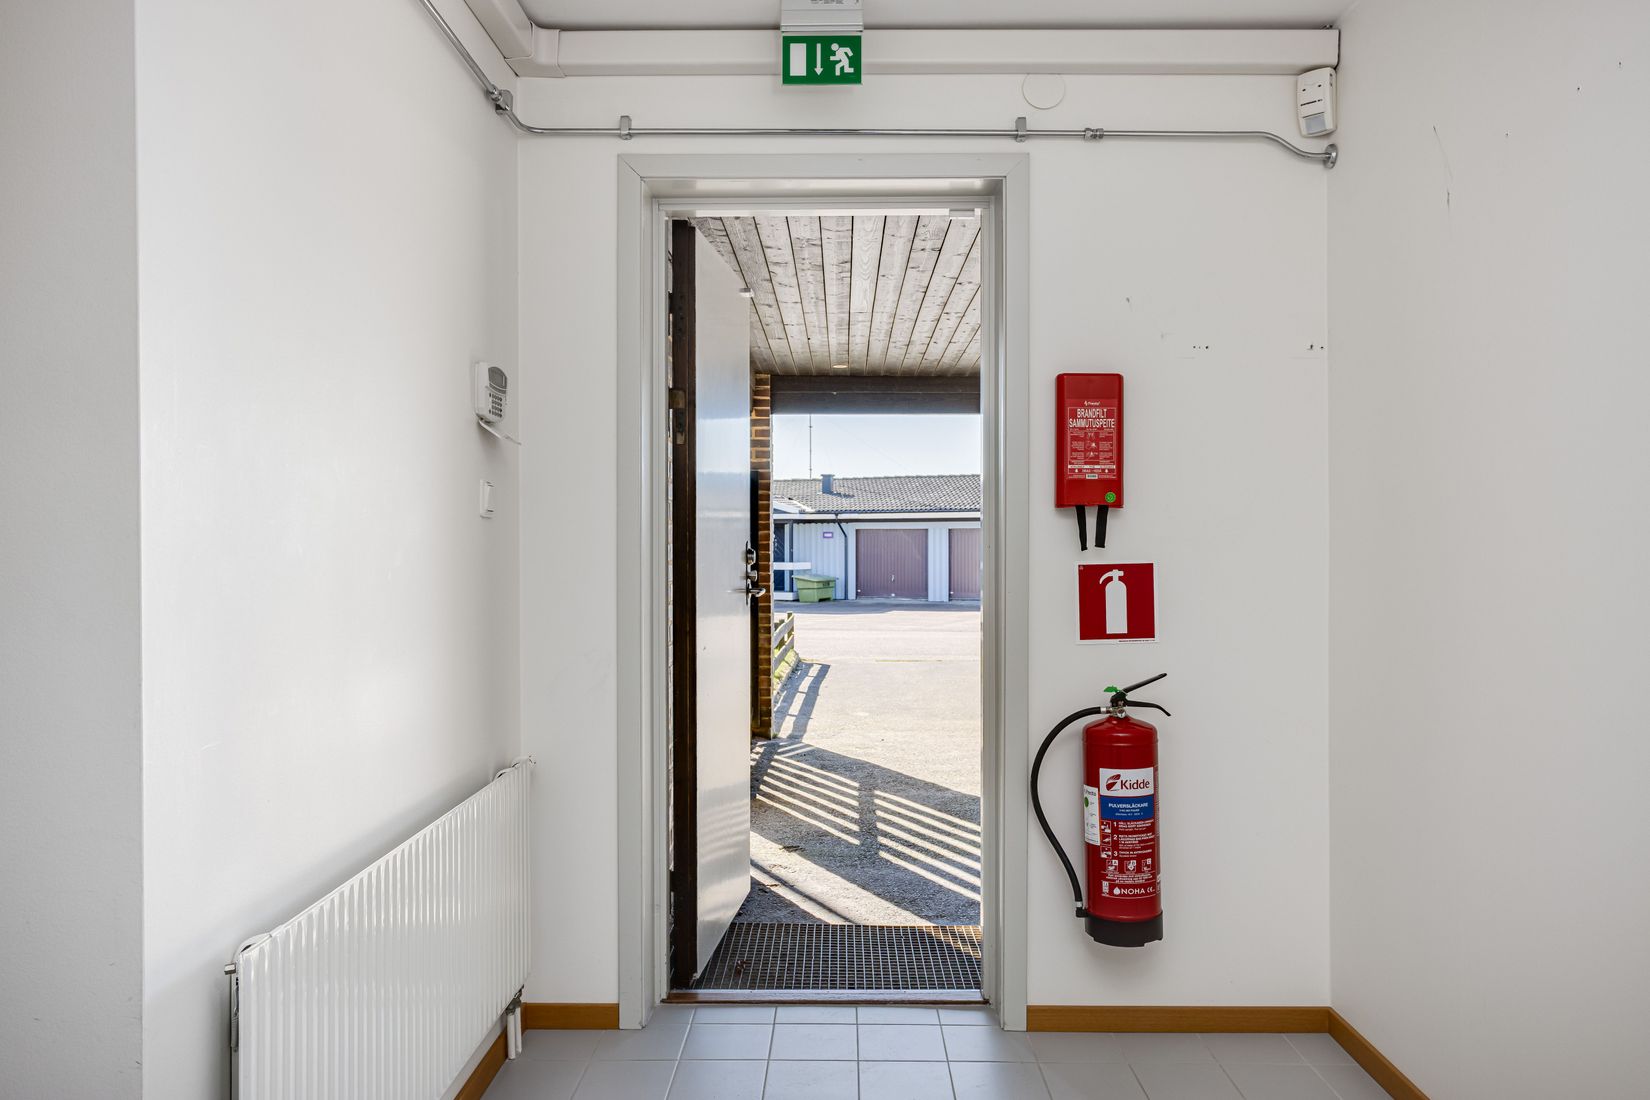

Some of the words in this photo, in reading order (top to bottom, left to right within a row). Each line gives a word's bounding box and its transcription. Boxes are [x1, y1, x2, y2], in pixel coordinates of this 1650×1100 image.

[1076, 408, 1107, 418] BRANDFILT
[1069, 418, 1115, 428] SAMMUTUSPEITE
[1120, 778, 1150, 790] Kidde
[1121, 887, 1146, 895] NOHA
